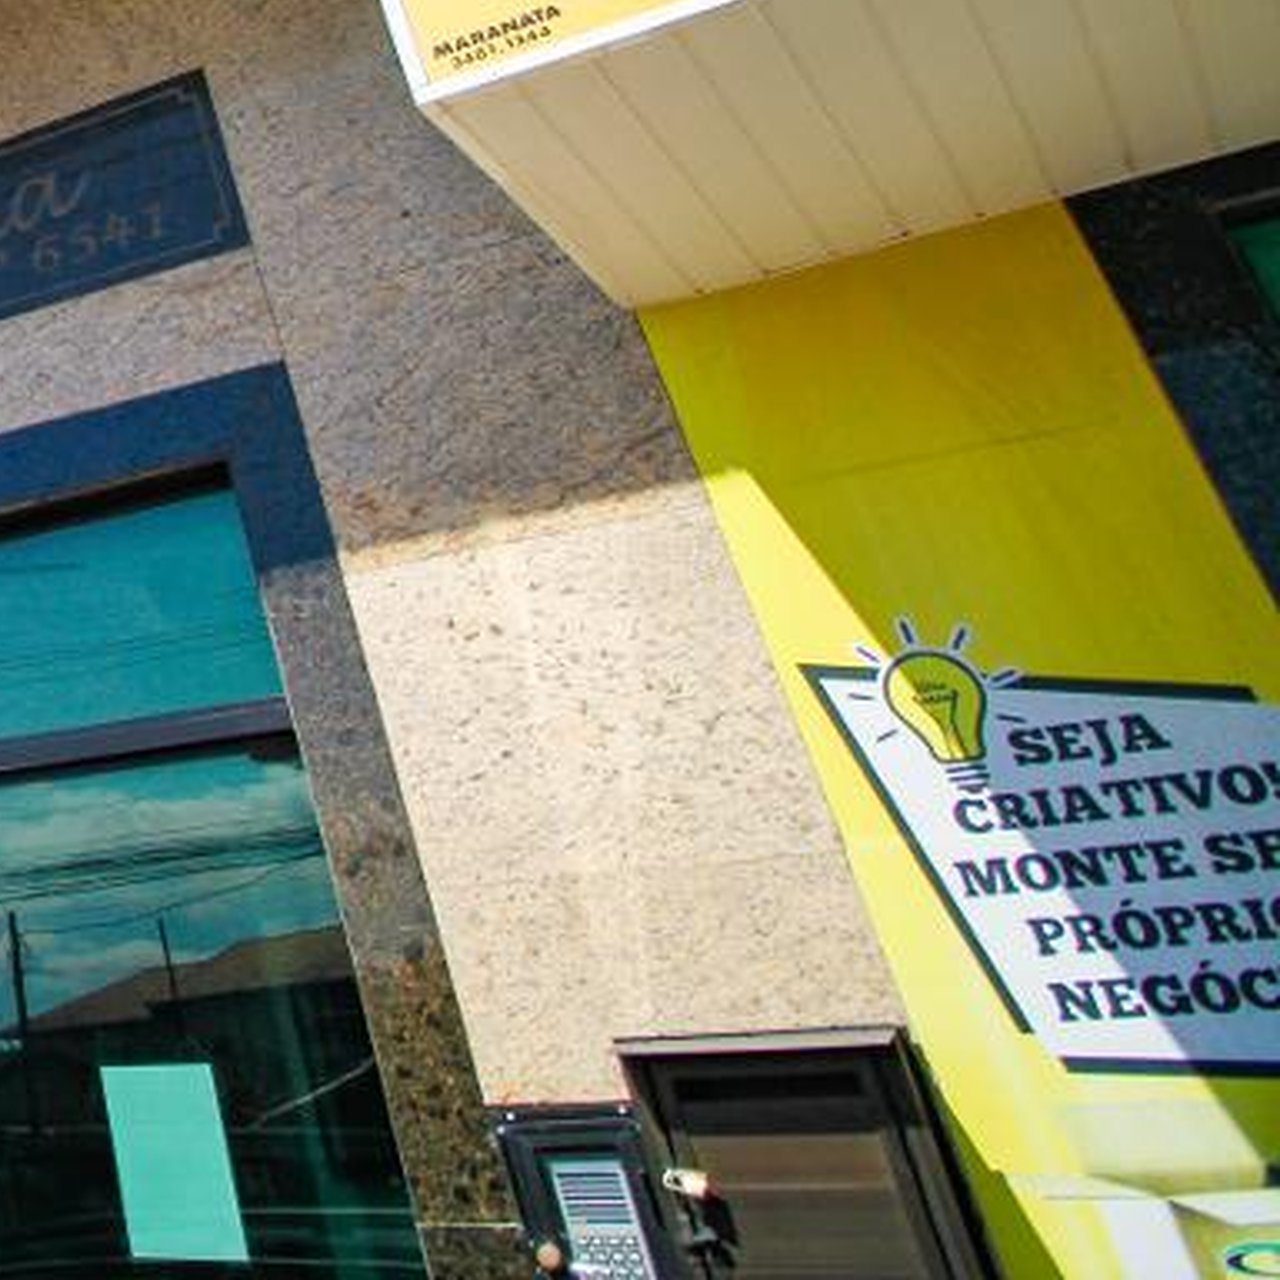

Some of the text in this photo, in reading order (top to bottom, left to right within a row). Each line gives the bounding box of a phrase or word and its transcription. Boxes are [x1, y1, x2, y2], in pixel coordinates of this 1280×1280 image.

[433, 5, 561, 59] MARANATA
[1007, 713, 1172, 767] SEJA
[953, 828, 1280, 898] MONTE SE
[1027, 896, 1280, 957] PRÓPRI
